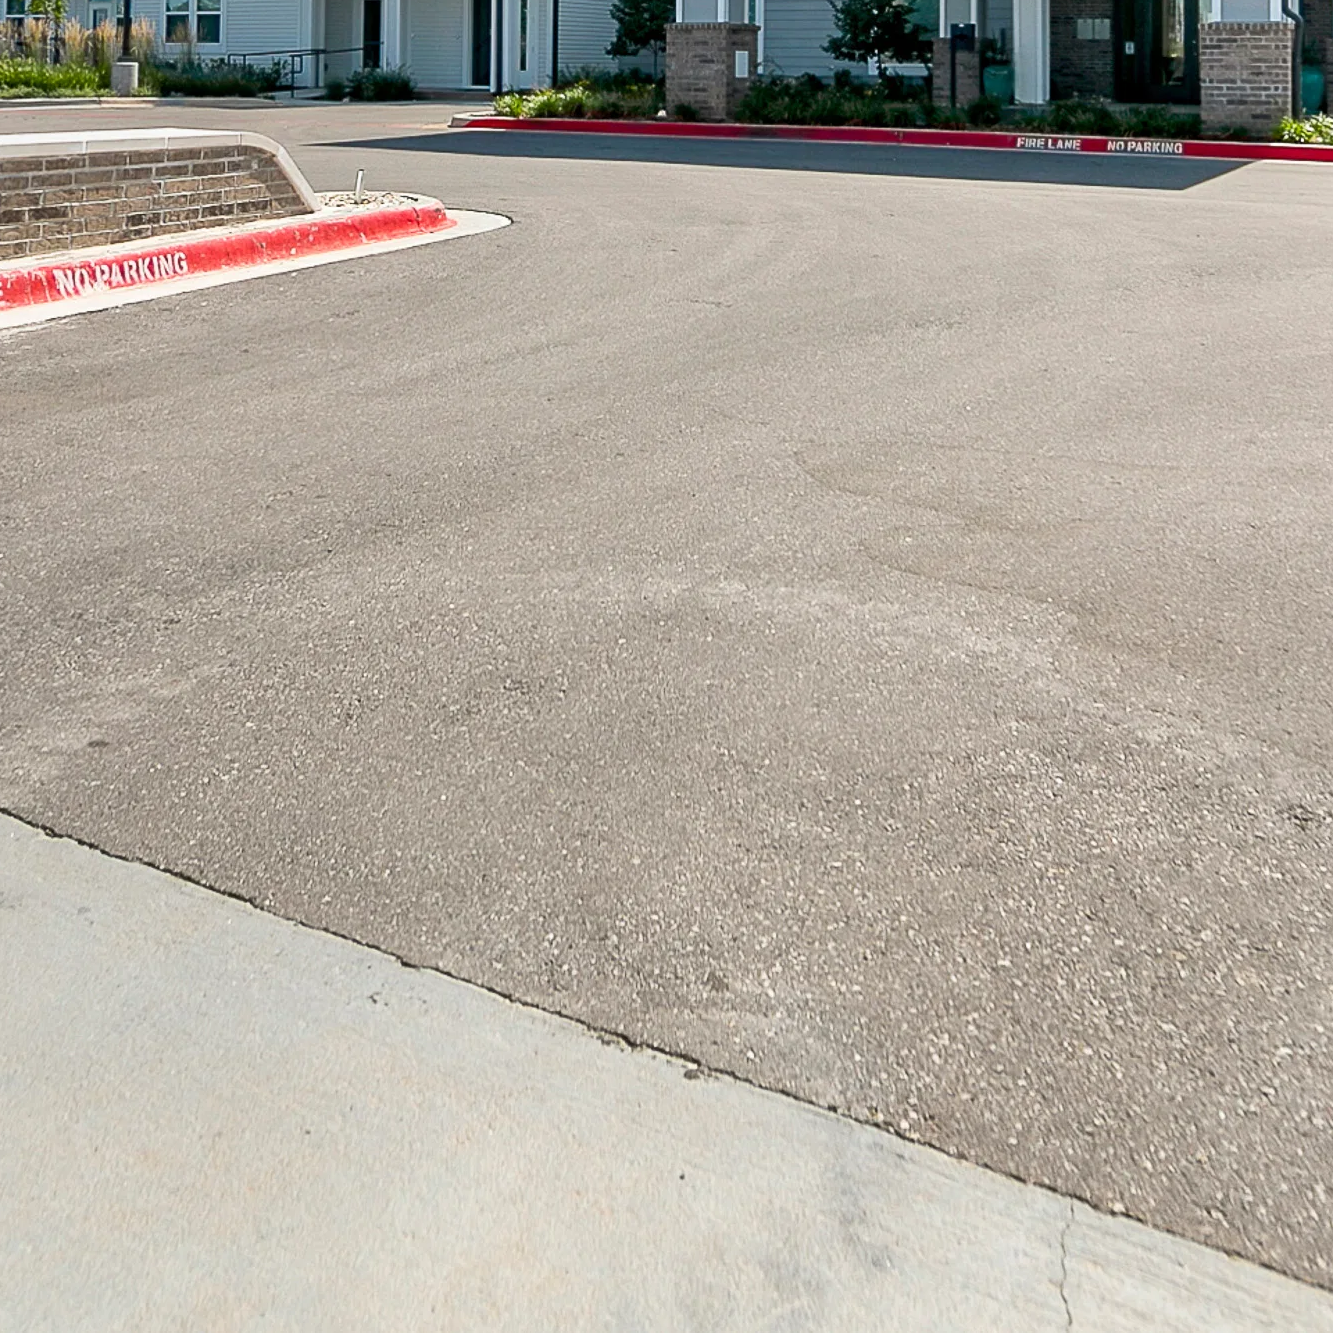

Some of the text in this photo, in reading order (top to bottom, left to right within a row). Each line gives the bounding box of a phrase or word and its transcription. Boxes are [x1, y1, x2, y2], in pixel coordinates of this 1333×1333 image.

[1017, 137, 1184, 154] FIRE LANE NO PARKING
[52, 266, 93, 299] NO
[94, 251, 189, 291] PARKING
